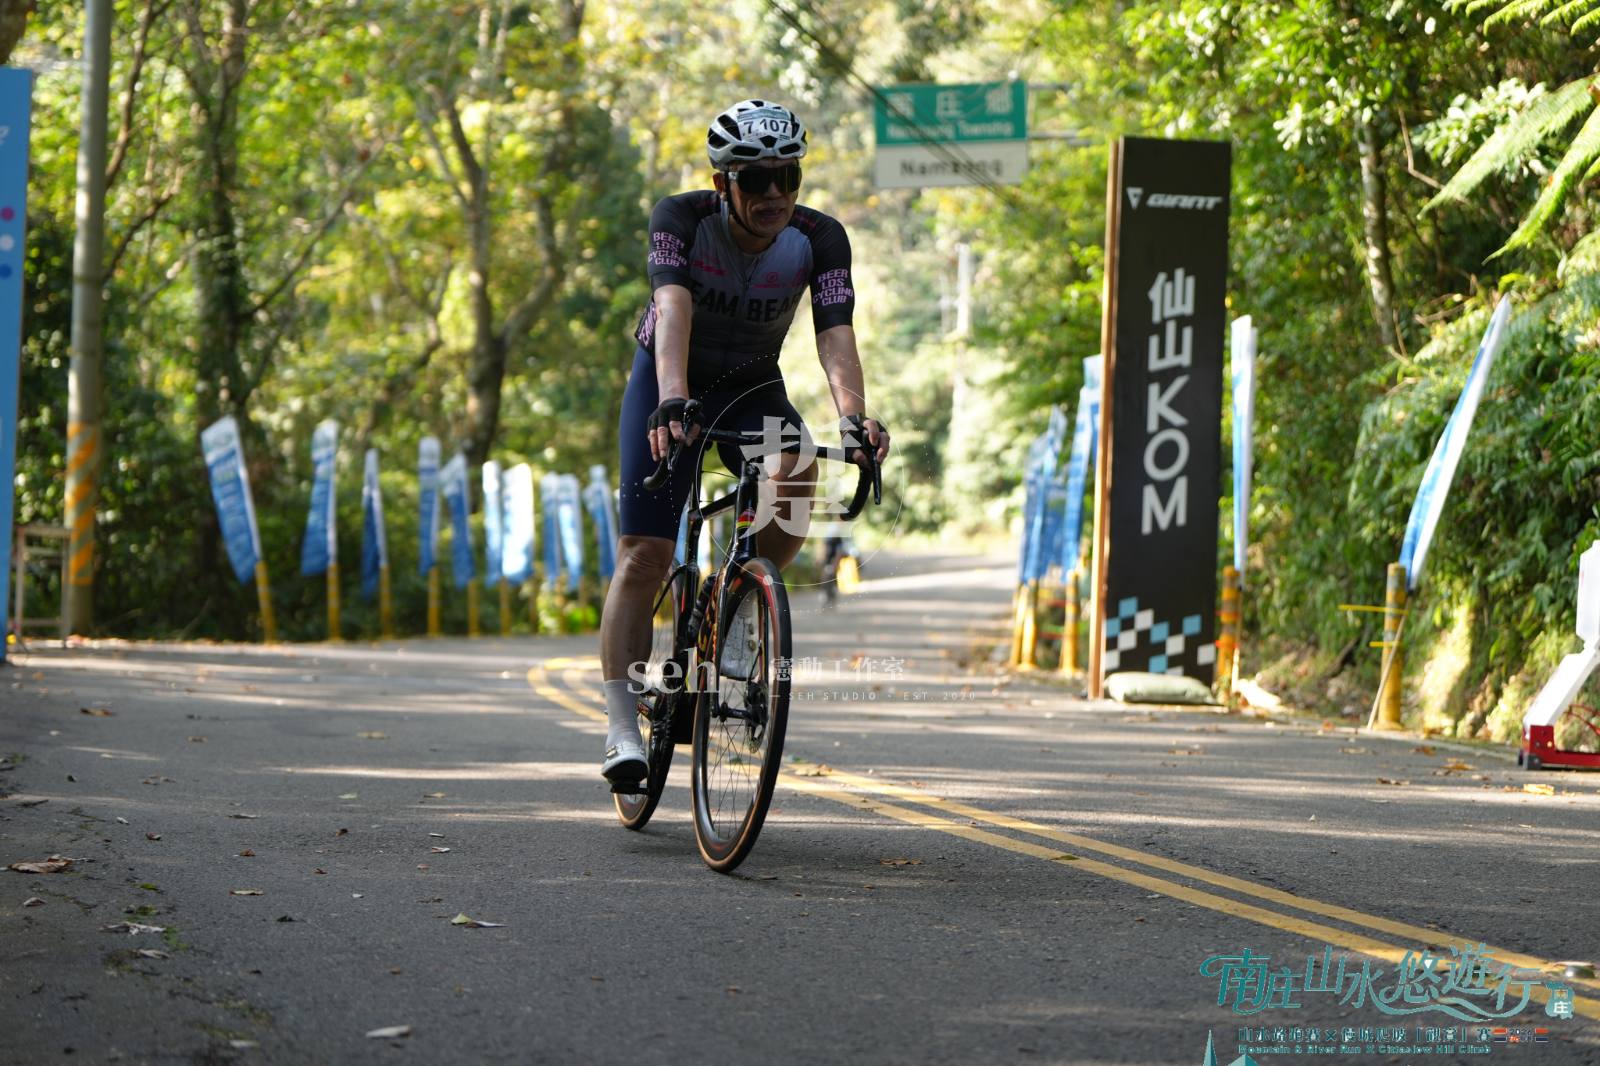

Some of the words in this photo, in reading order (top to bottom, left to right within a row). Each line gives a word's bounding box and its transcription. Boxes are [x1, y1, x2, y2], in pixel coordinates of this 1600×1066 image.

[760, 118, 789, 133] 107
[1146, 193, 1222, 210] GIANT
[655, 257, 680, 267] CLUB
[818, 268, 849, 283] BEER
[692, 279, 740, 318] EAM
[813, 287, 853, 304] CYCLING
[822, 295, 847, 307] CLUB
